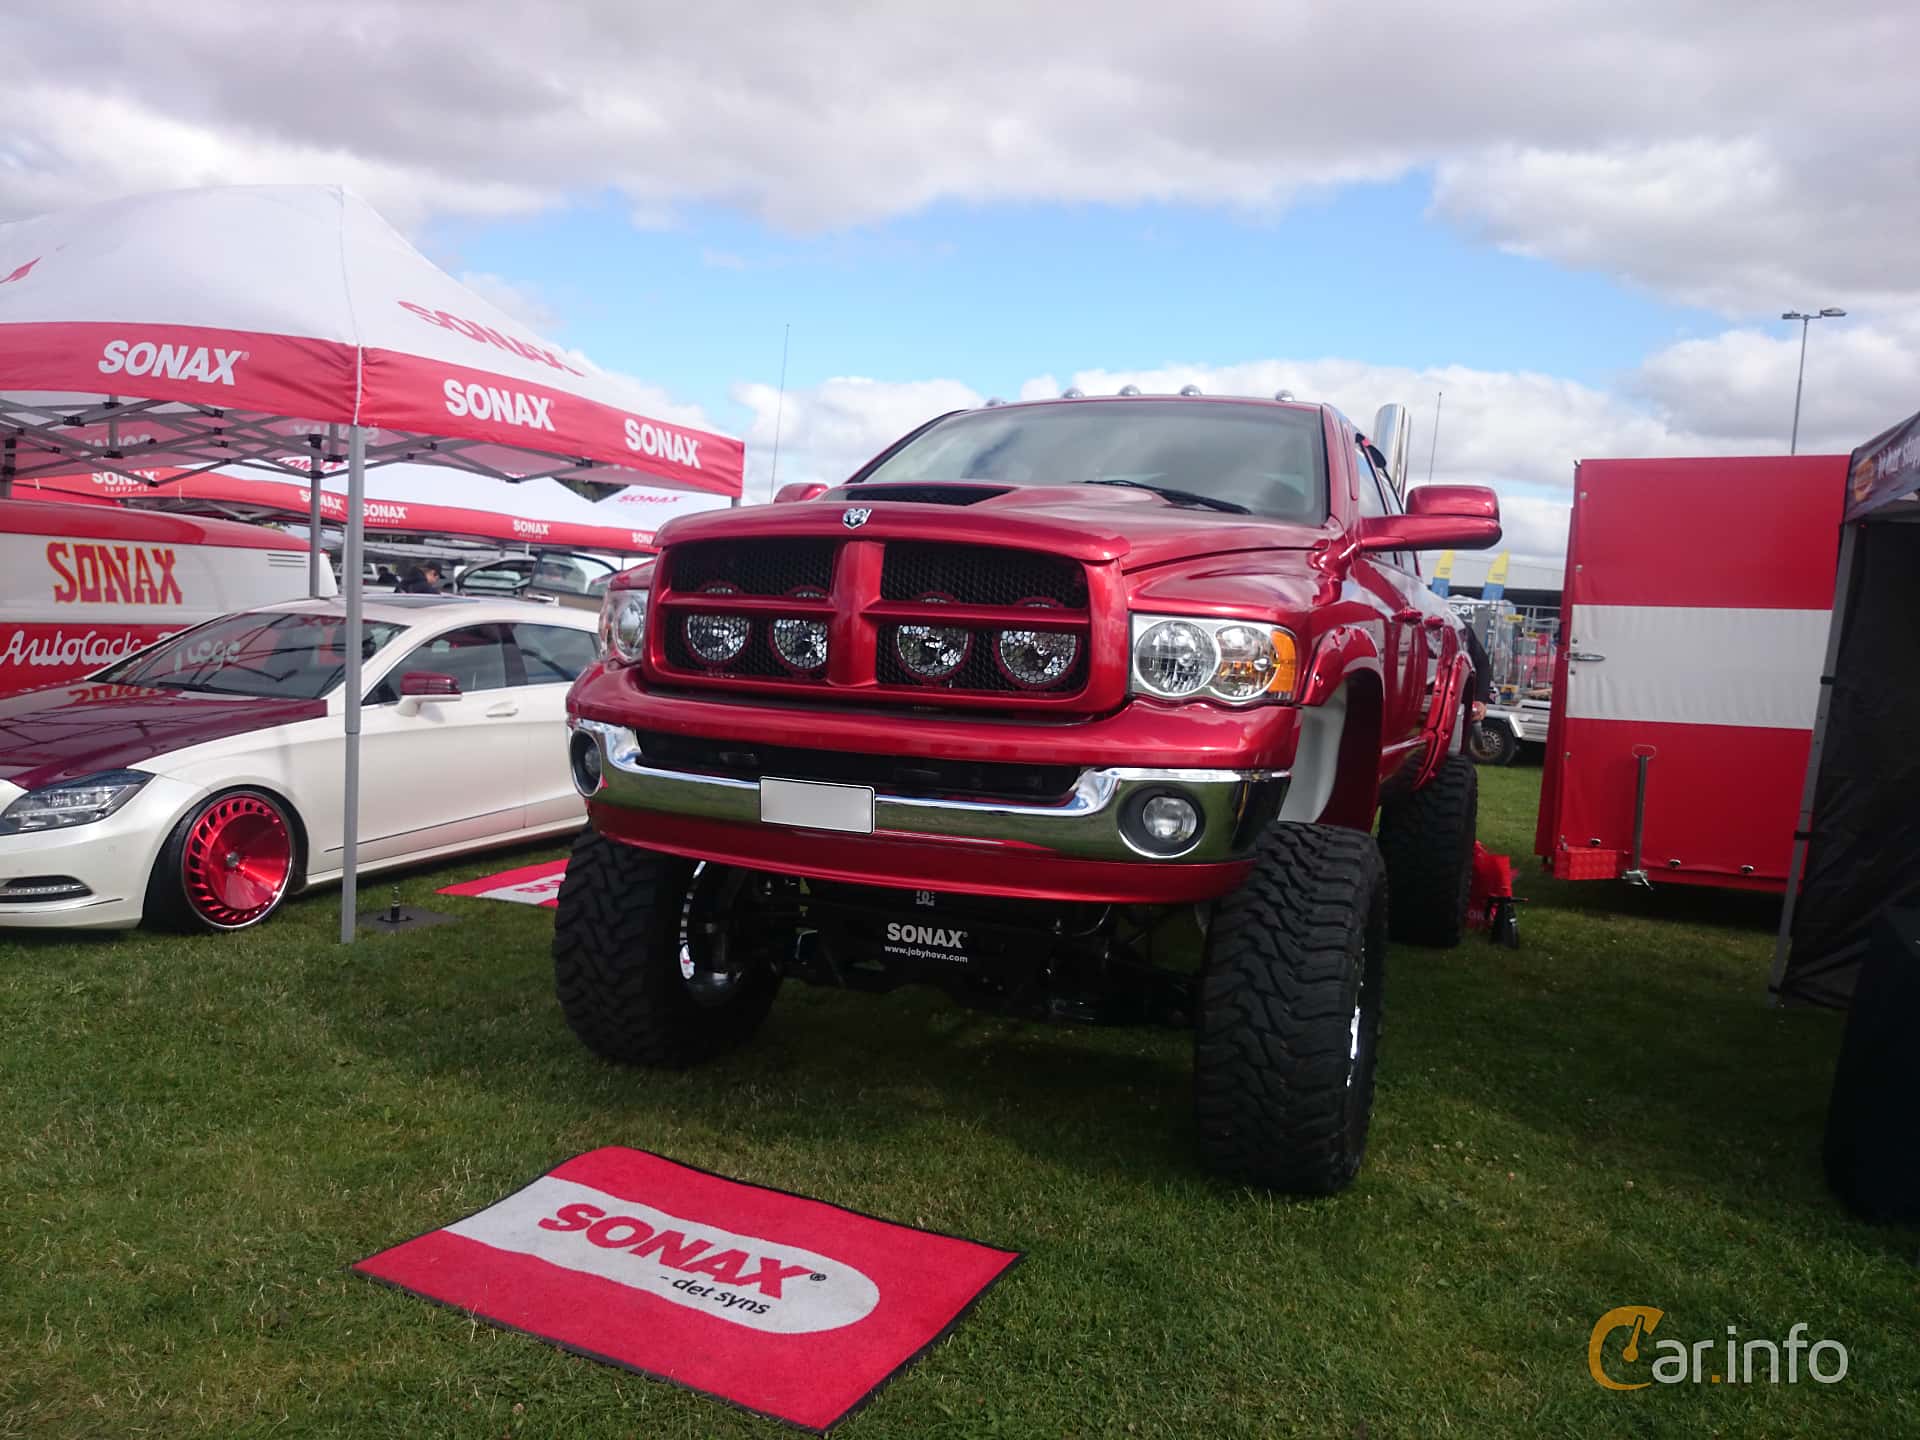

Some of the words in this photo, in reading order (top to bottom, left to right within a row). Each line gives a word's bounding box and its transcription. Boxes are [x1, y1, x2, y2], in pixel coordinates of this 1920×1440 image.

[98, 340, 242, 385] SONAX
[443, 379, 556, 432] SONAX
[624, 418, 702, 469] SONAX
[299, 489, 343, 511] SNAX
[513, 519, 549, 536] SONAX
[46, 541, 182, 605] SONAX
[887, 922, 963, 949] SONAX
[672, 1277, 715, 1298] det
[714, 1289, 771, 1315] syns
